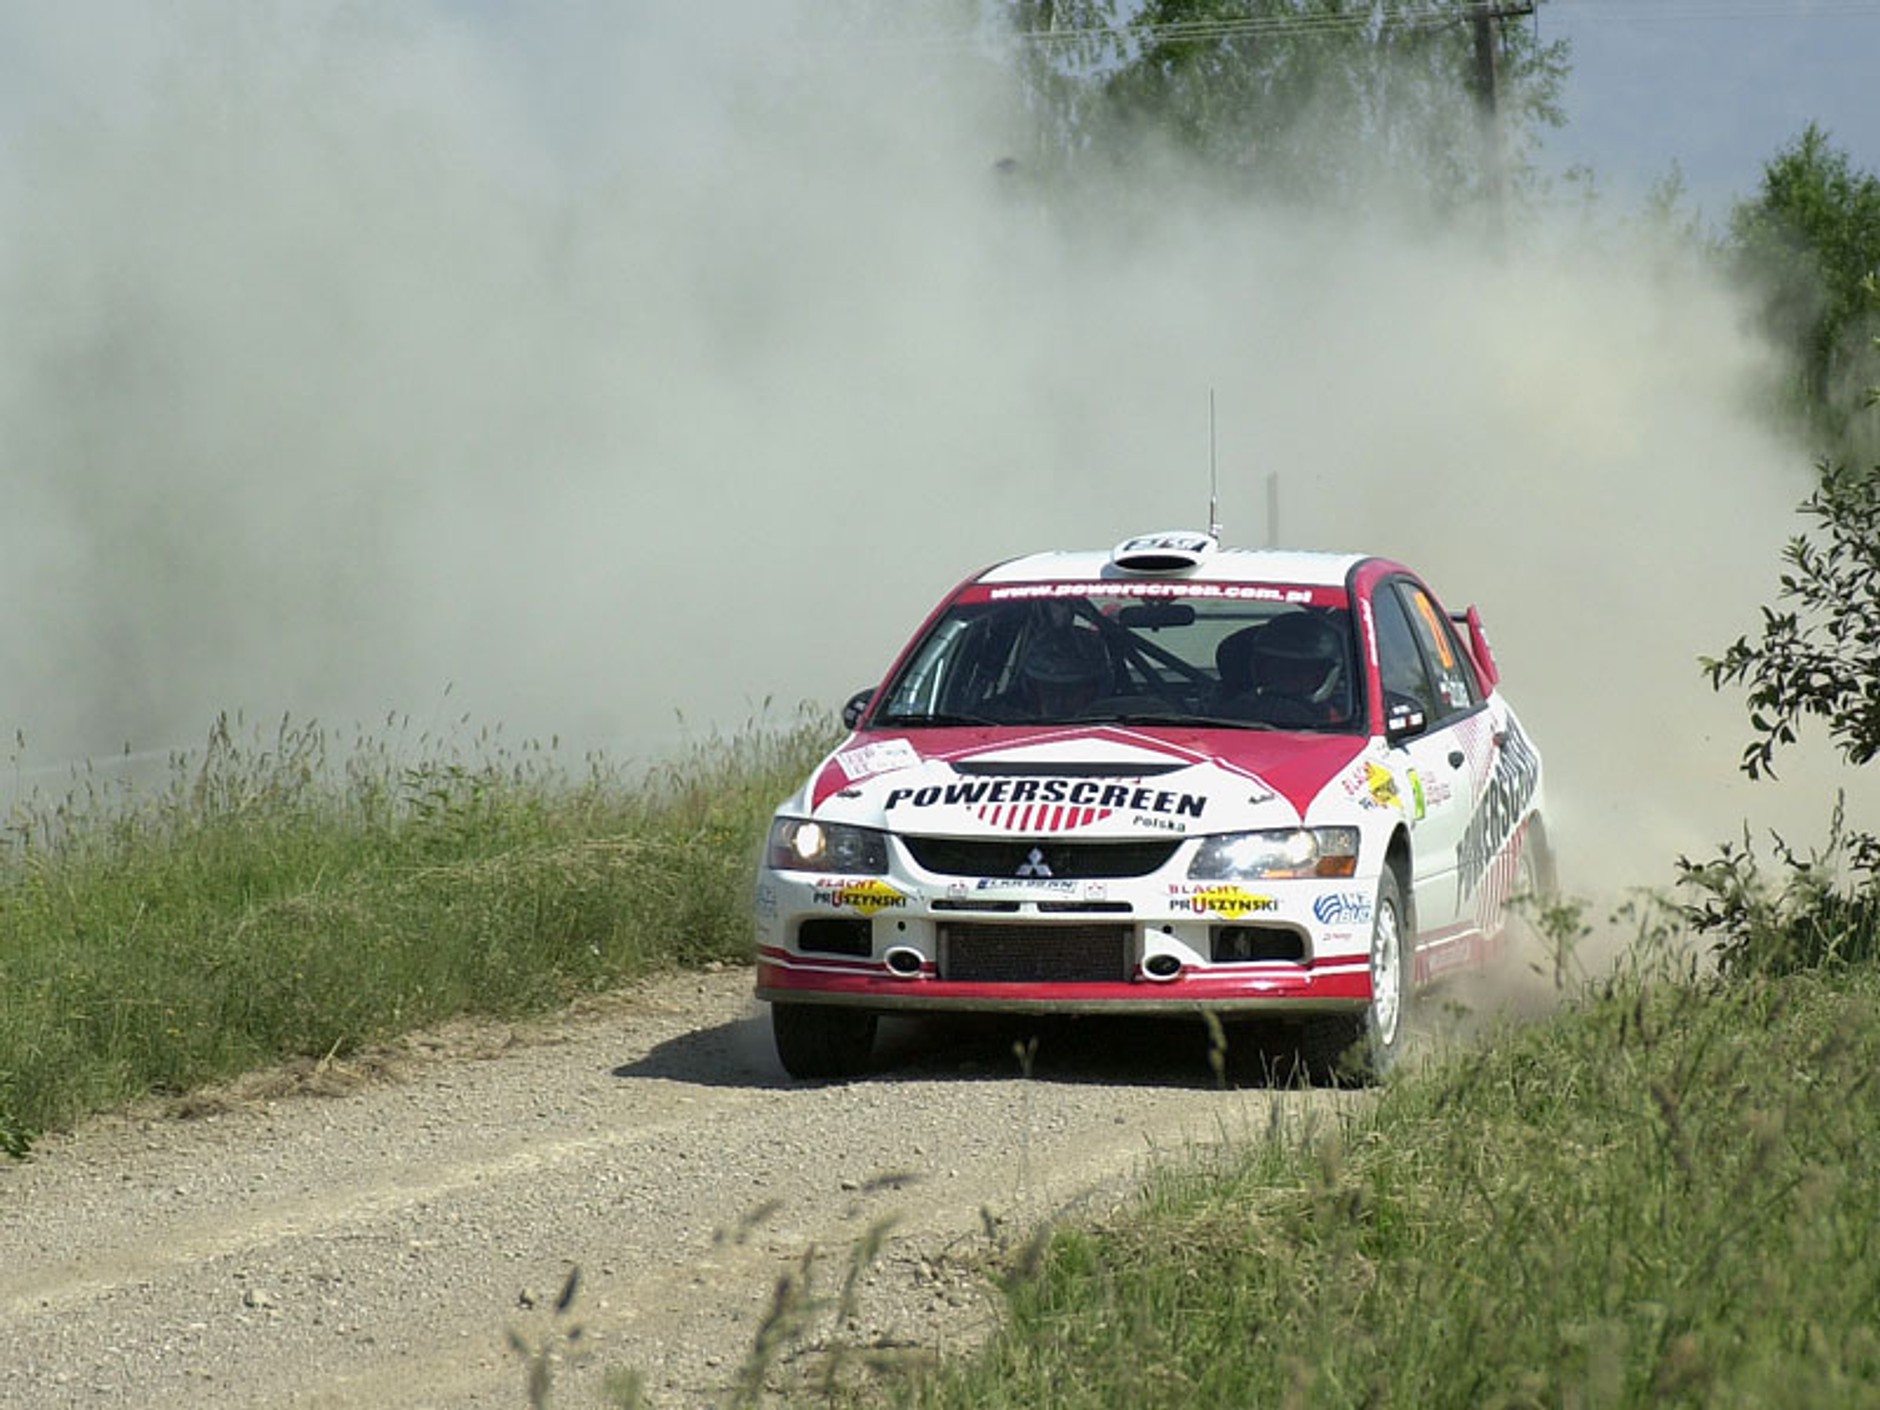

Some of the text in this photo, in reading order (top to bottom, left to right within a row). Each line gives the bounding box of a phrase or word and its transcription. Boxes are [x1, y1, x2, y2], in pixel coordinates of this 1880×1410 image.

[991, 584, 1312, 602] www.powerscreen.com.pl
[885, 780, 1207, 818] POWERSCREEN
[1133, 815, 1186, 832] Polska
